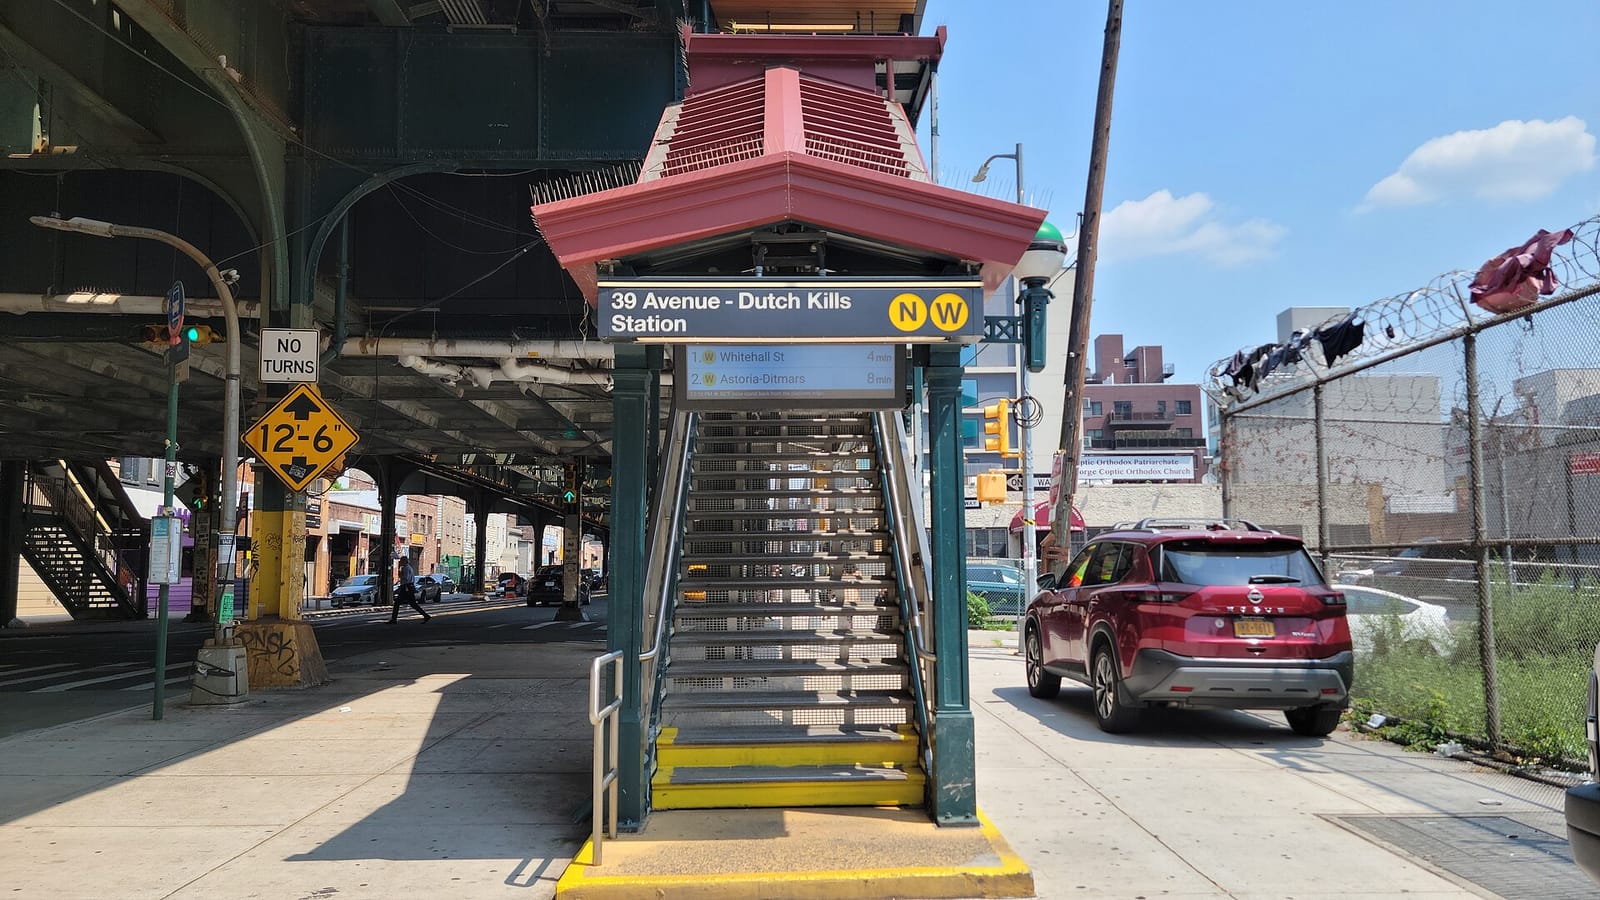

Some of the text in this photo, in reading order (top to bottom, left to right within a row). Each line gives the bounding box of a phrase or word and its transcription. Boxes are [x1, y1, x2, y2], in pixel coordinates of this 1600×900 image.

[611, 292, 637, 310] 39
[642, 292, 721, 310] Avenue
[738, 292, 800, 310] Dutch
[807, 292, 852, 310] Kills
[936, 302, 963, 324] W
[611, 314, 687, 332] Station
[277, 338, 302, 353] NO
[720, 351, 771, 363] Whitehall
[773, 351, 785, 363] St
[263, 359, 315, 374] TURNS
[720, 373, 806, 385] Astoria-Ditmars
[1080, 458, 1180, 467] ptic Orthodox Patriarchate
[1098, 468, 1124, 476] Coptic
[1011, 478, 1052, 486] ON WA
